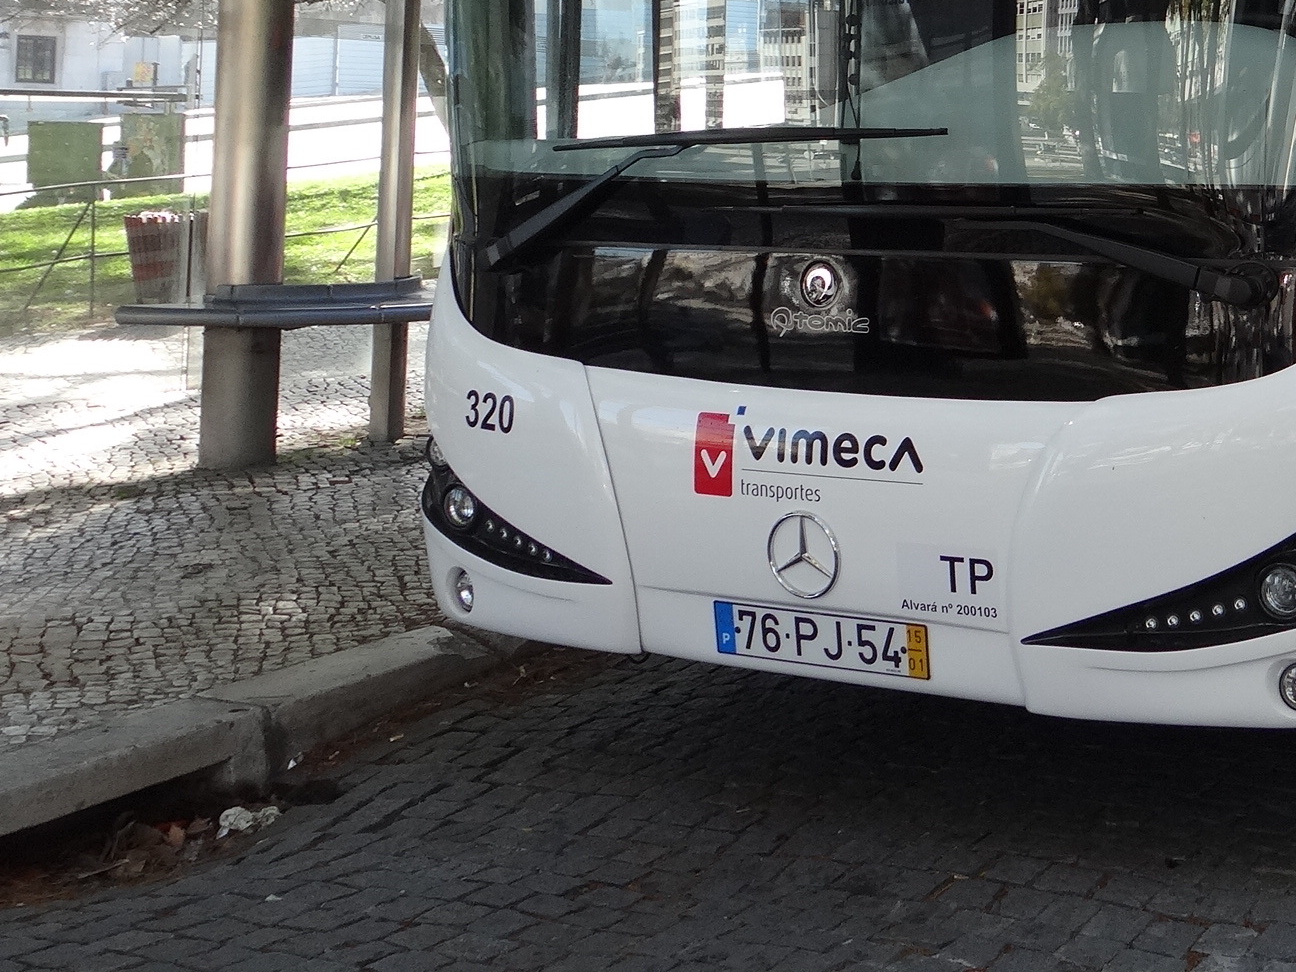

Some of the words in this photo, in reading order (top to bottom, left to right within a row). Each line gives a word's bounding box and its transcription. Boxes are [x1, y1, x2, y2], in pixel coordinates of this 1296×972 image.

[465, 389, 515, 434] 320
[740, 479, 821, 502] transportes
[939, 555, 994, 595] TP
[901, 599, 938, 613] Alvará
[956, 604, 998, 619] 200103
[722, 632, 731, 644] P
[906, 629, 922, 644] 15
[908, 657, 924, 672] 01
